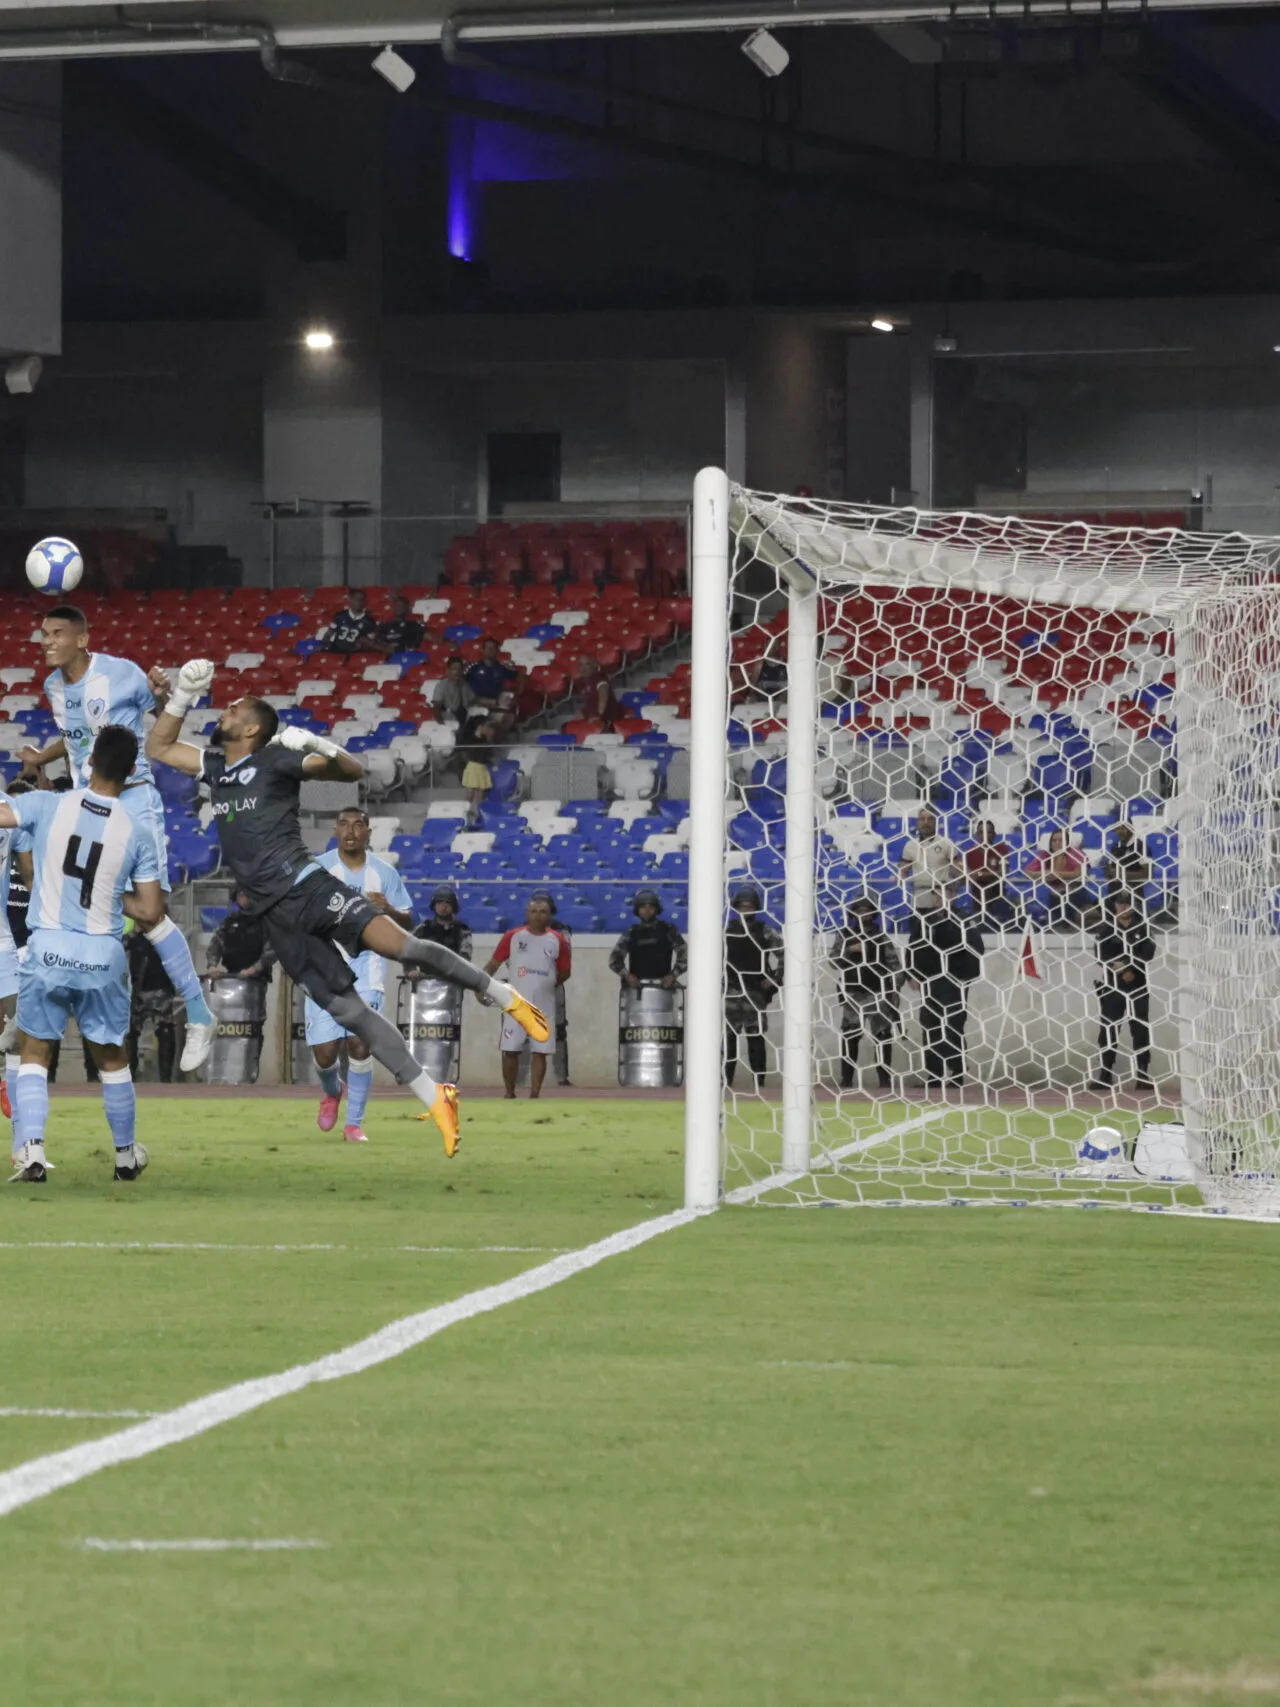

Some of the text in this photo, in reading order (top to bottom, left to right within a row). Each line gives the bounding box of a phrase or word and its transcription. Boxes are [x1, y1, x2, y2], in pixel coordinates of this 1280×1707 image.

[338, 626, 359, 642] 33
[63, 834, 104, 909] 4
[58, 956, 111, 973] UniCesumar
[217, 1024, 253, 1037] OQUE
[625, 1027, 678, 1041] CHOQUE
